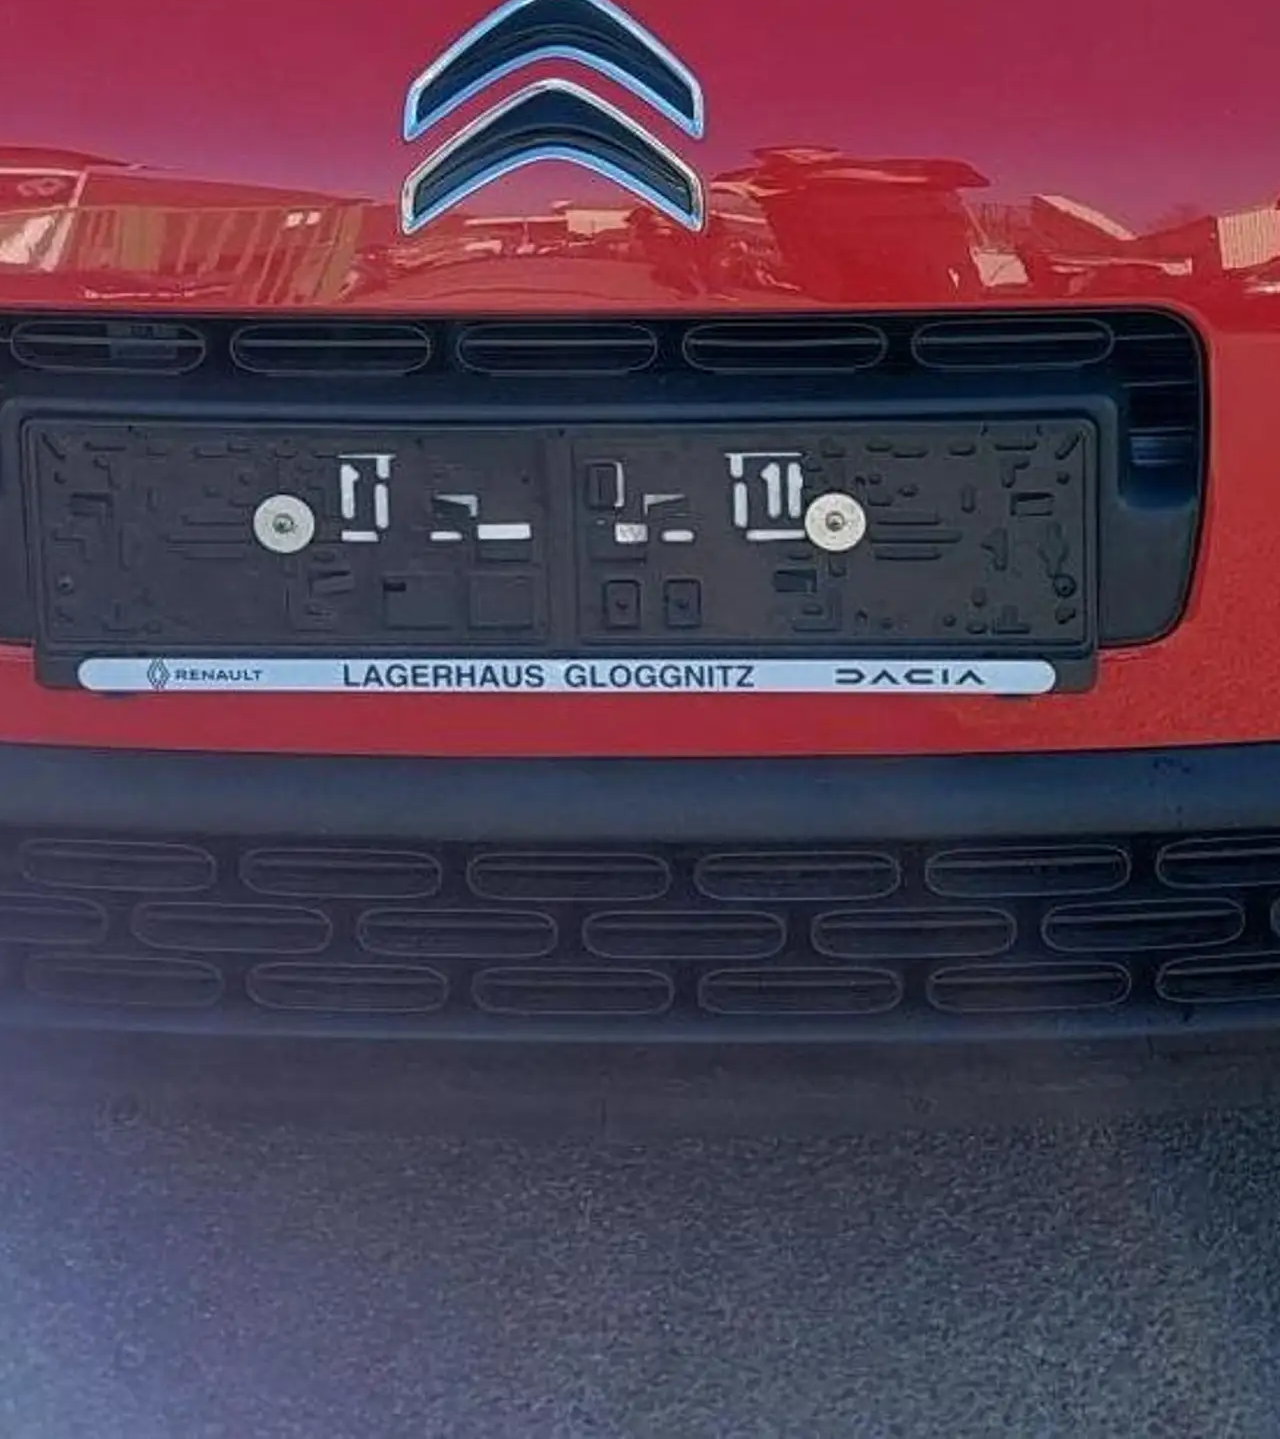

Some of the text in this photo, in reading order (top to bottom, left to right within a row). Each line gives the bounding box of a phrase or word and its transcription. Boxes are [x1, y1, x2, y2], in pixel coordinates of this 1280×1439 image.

[174, 668, 263, 681] RENAULT
[342, 663, 755, 689] LAGERHAUS GLOGGNITZ
[834, 668, 986, 685] DACIA
